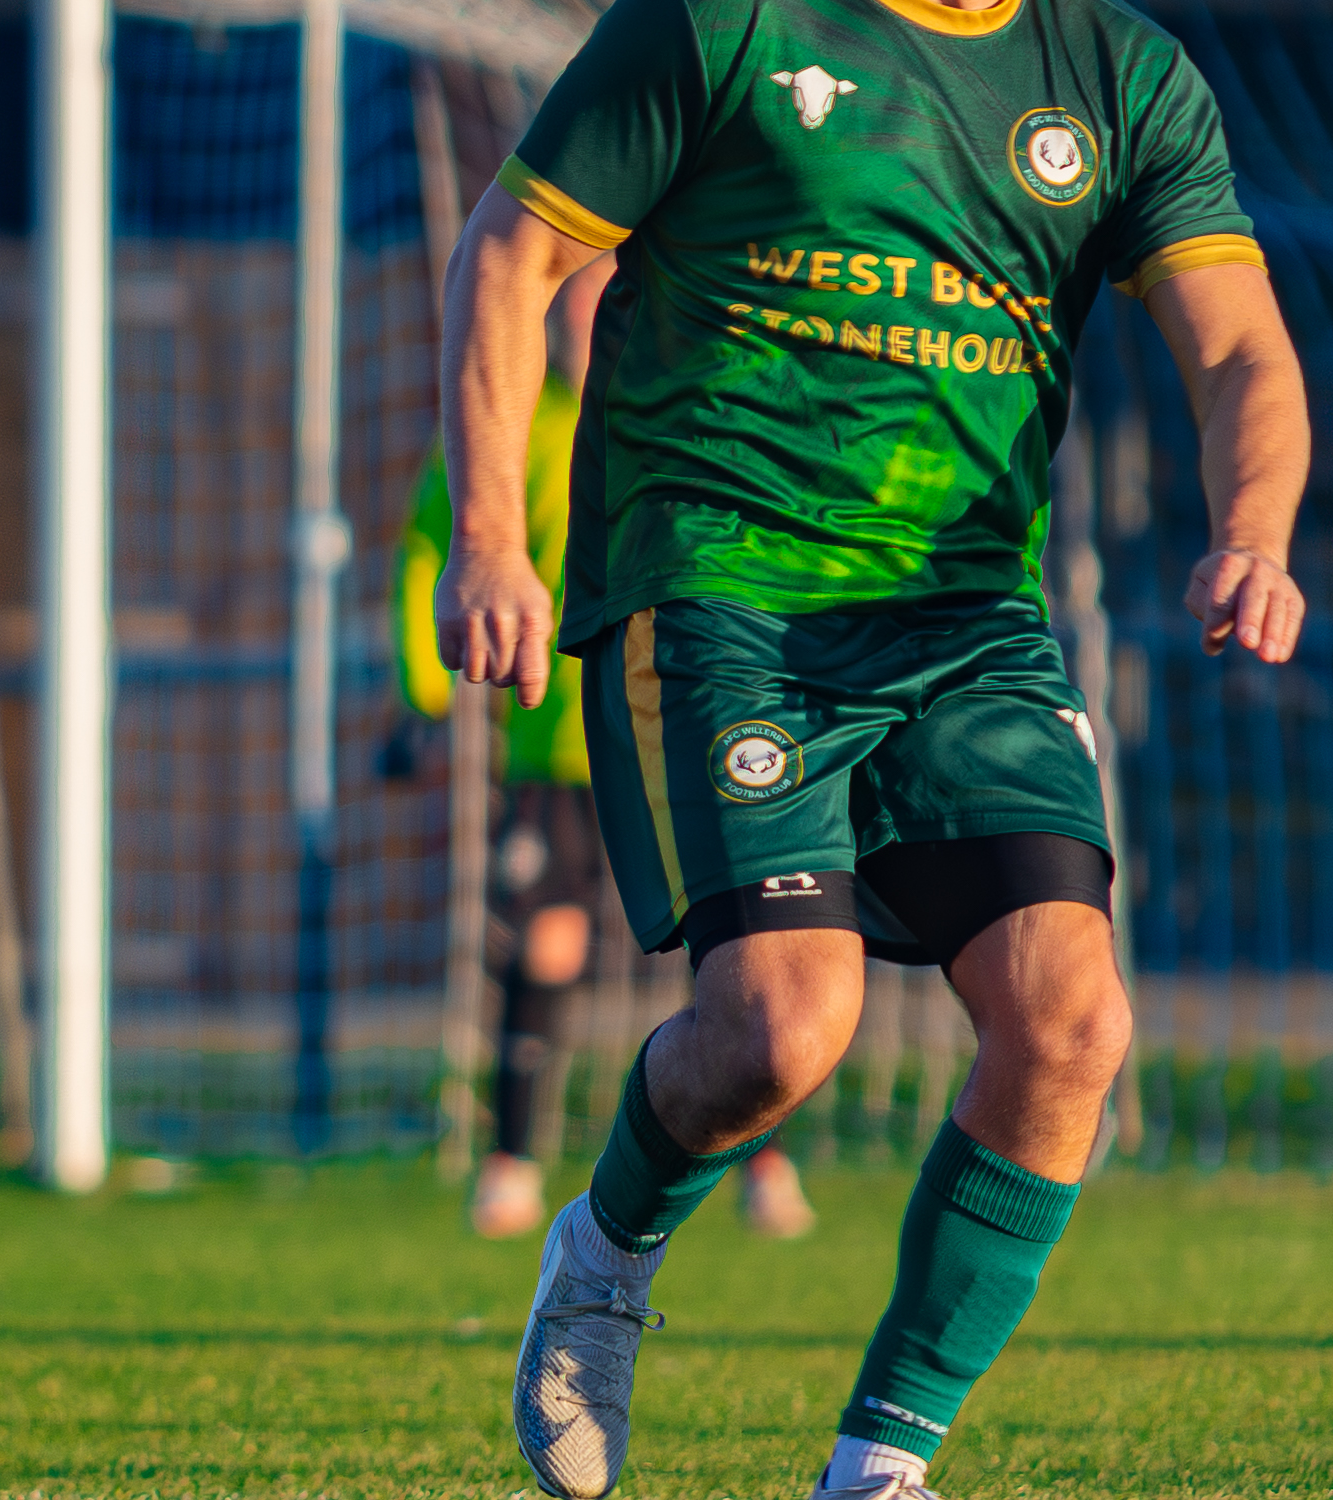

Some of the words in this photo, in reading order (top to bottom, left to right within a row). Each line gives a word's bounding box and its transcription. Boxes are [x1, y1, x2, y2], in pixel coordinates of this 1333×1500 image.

[746, 242, 918, 299] WEST
[726, 302, 1050, 376] STONEHOU
[722, 730, 742, 747] AFC
[740, 726, 788, 746] WILLERBY
[723, 781, 771, 799] FOOTBALL
[771, 778, 792, 795] CLUB
